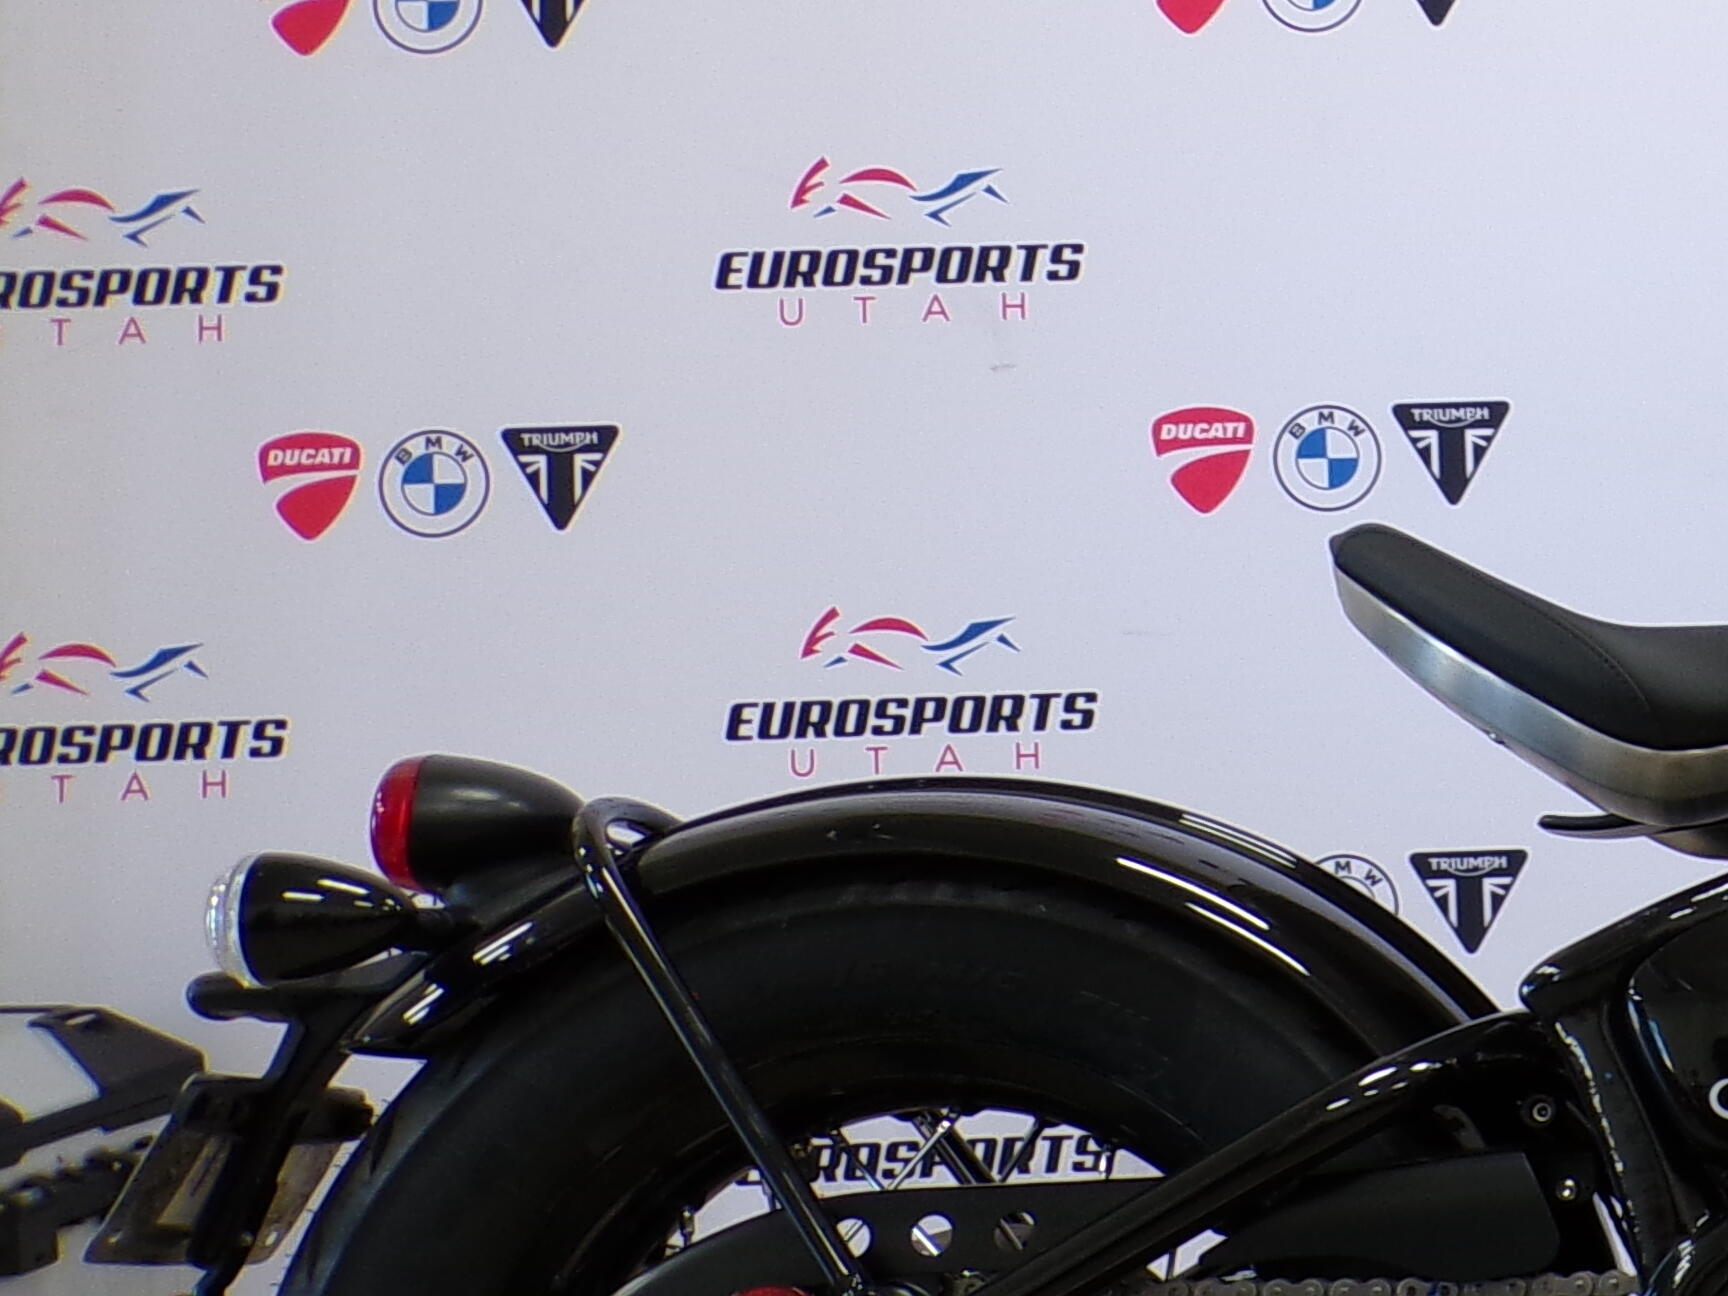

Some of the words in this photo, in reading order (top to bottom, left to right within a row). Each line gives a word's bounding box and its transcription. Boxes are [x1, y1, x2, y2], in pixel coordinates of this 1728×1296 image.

[716, 244, 1084, 289] EUROSPORTS
[778, 294, 1029, 328] UTAH
[51, 317, 224, 346] TAH
[1288, 411, 1366, 441] BMW
[1411, 407, 1491, 423] TRIUMPH
[520, 431, 600, 448] TRIUMPH
[1160, 422, 1245, 442] DUCATI
[266, 447, 352, 467] DUCATI
[395, 436, 475, 467] BMW
[727, 692, 1097, 740] EUROSPORTS
[790, 744, 1040, 779] UTAH
[52, 772, 229, 803] TAH
[1334, 860, 1383, 887] MW
[1428, 856, 1508, 872] TRIUMPH
